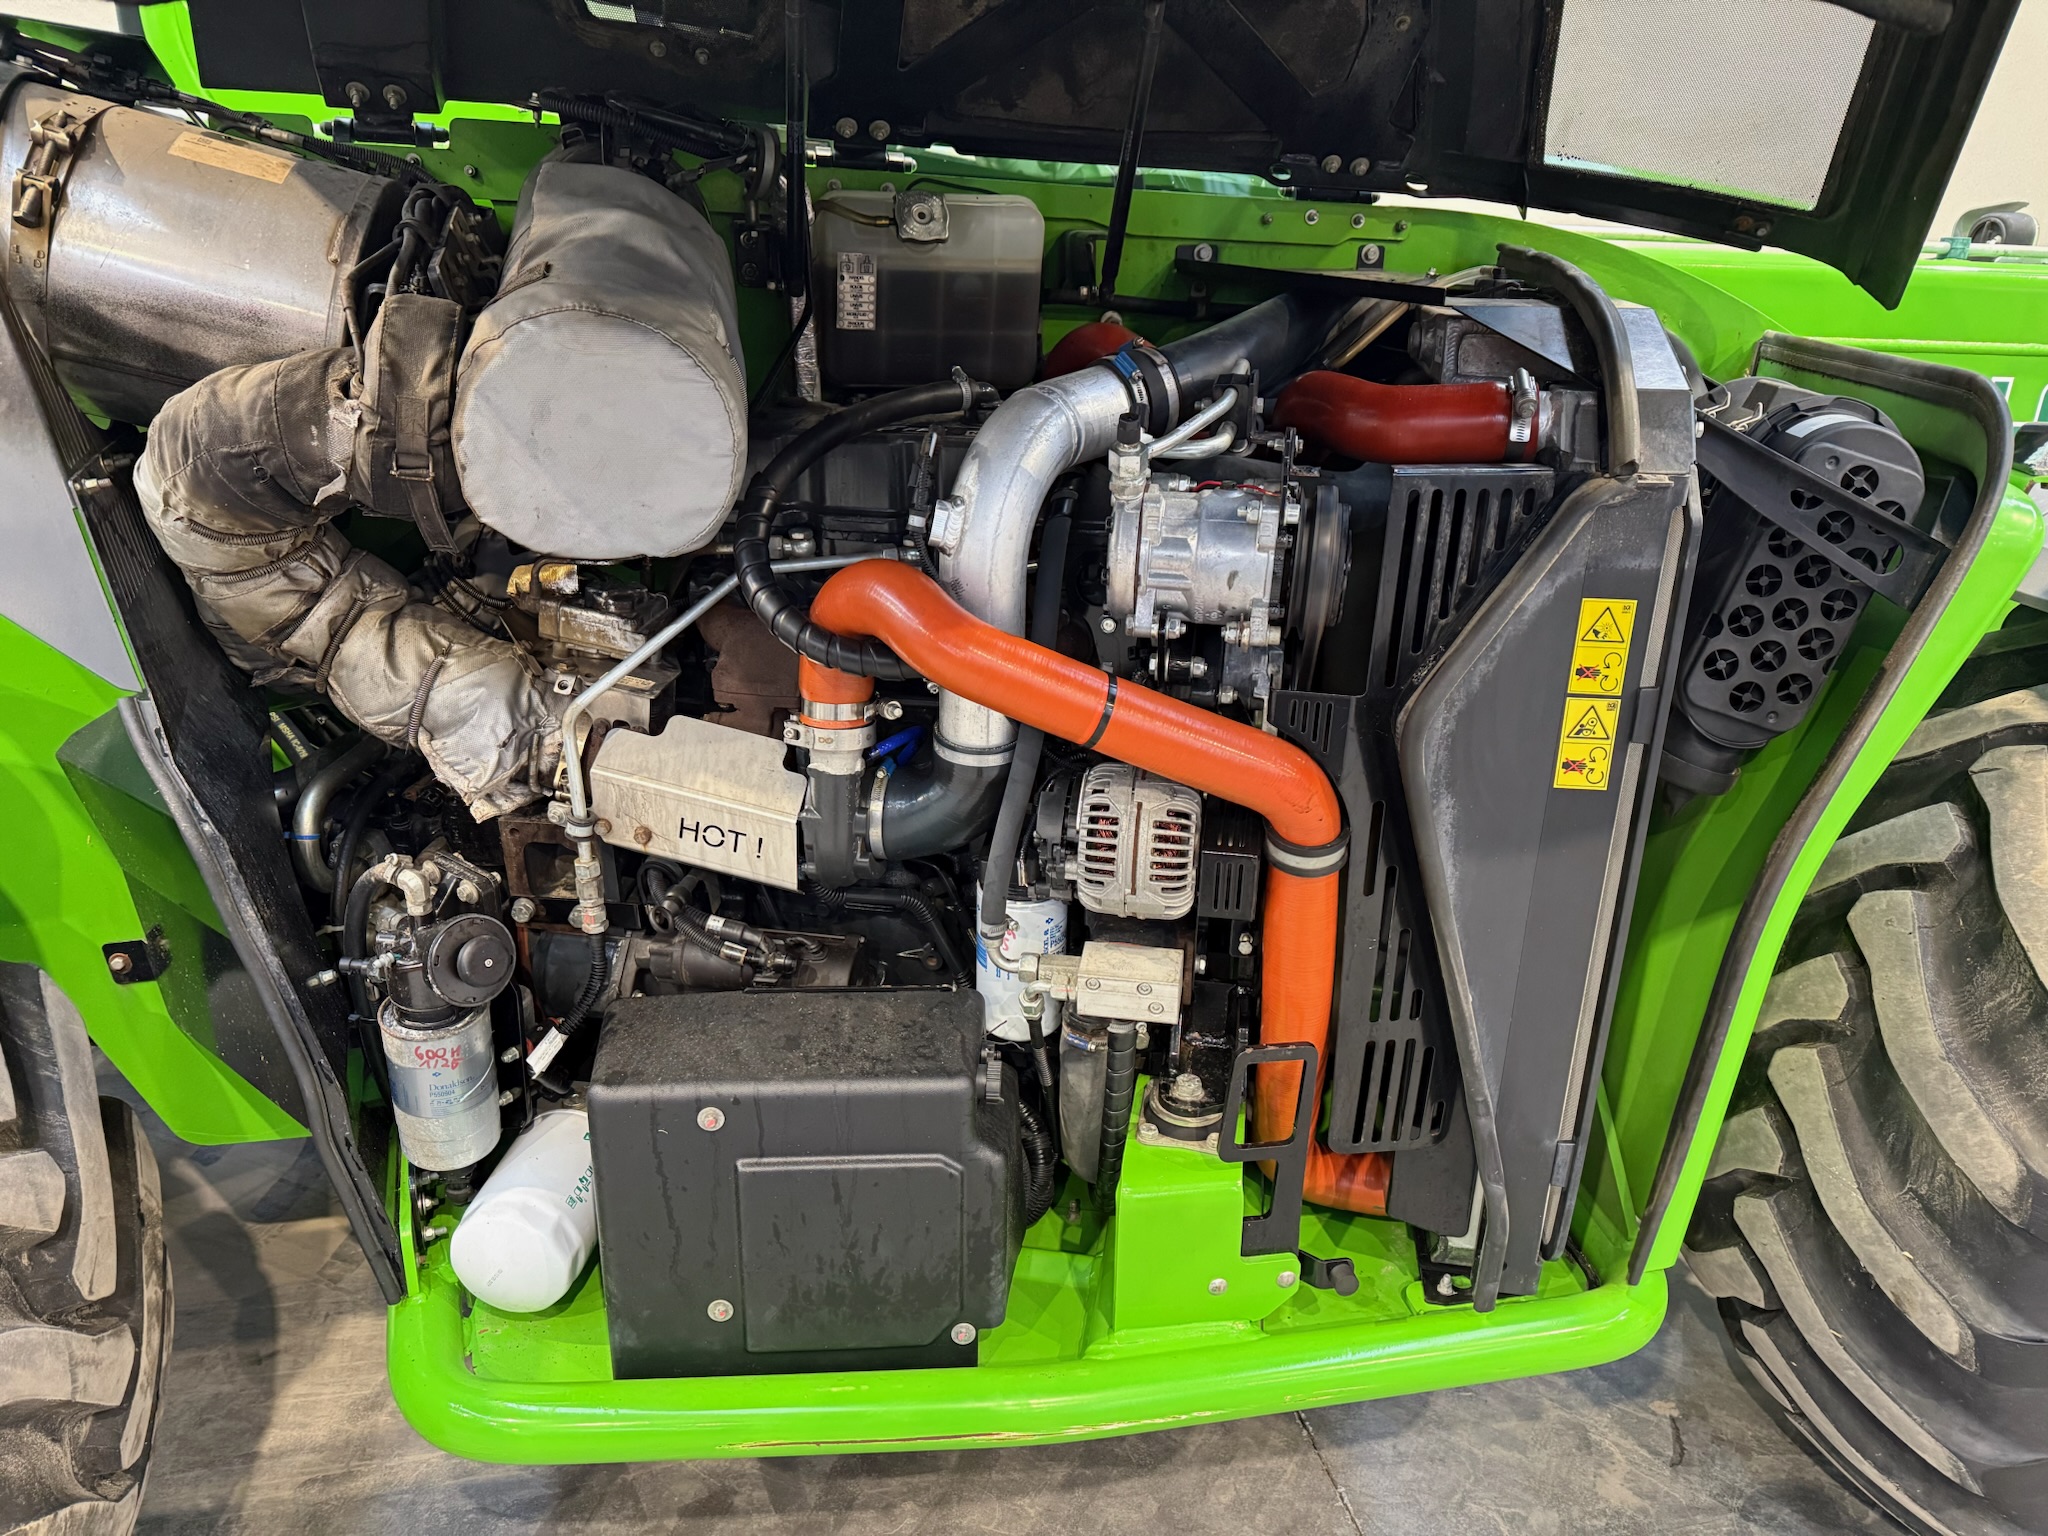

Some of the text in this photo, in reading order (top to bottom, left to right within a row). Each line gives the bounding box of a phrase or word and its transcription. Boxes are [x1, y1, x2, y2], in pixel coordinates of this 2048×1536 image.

[679, 817, 763, 859] HOT !
[414, 1045, 447, 1061] 600
